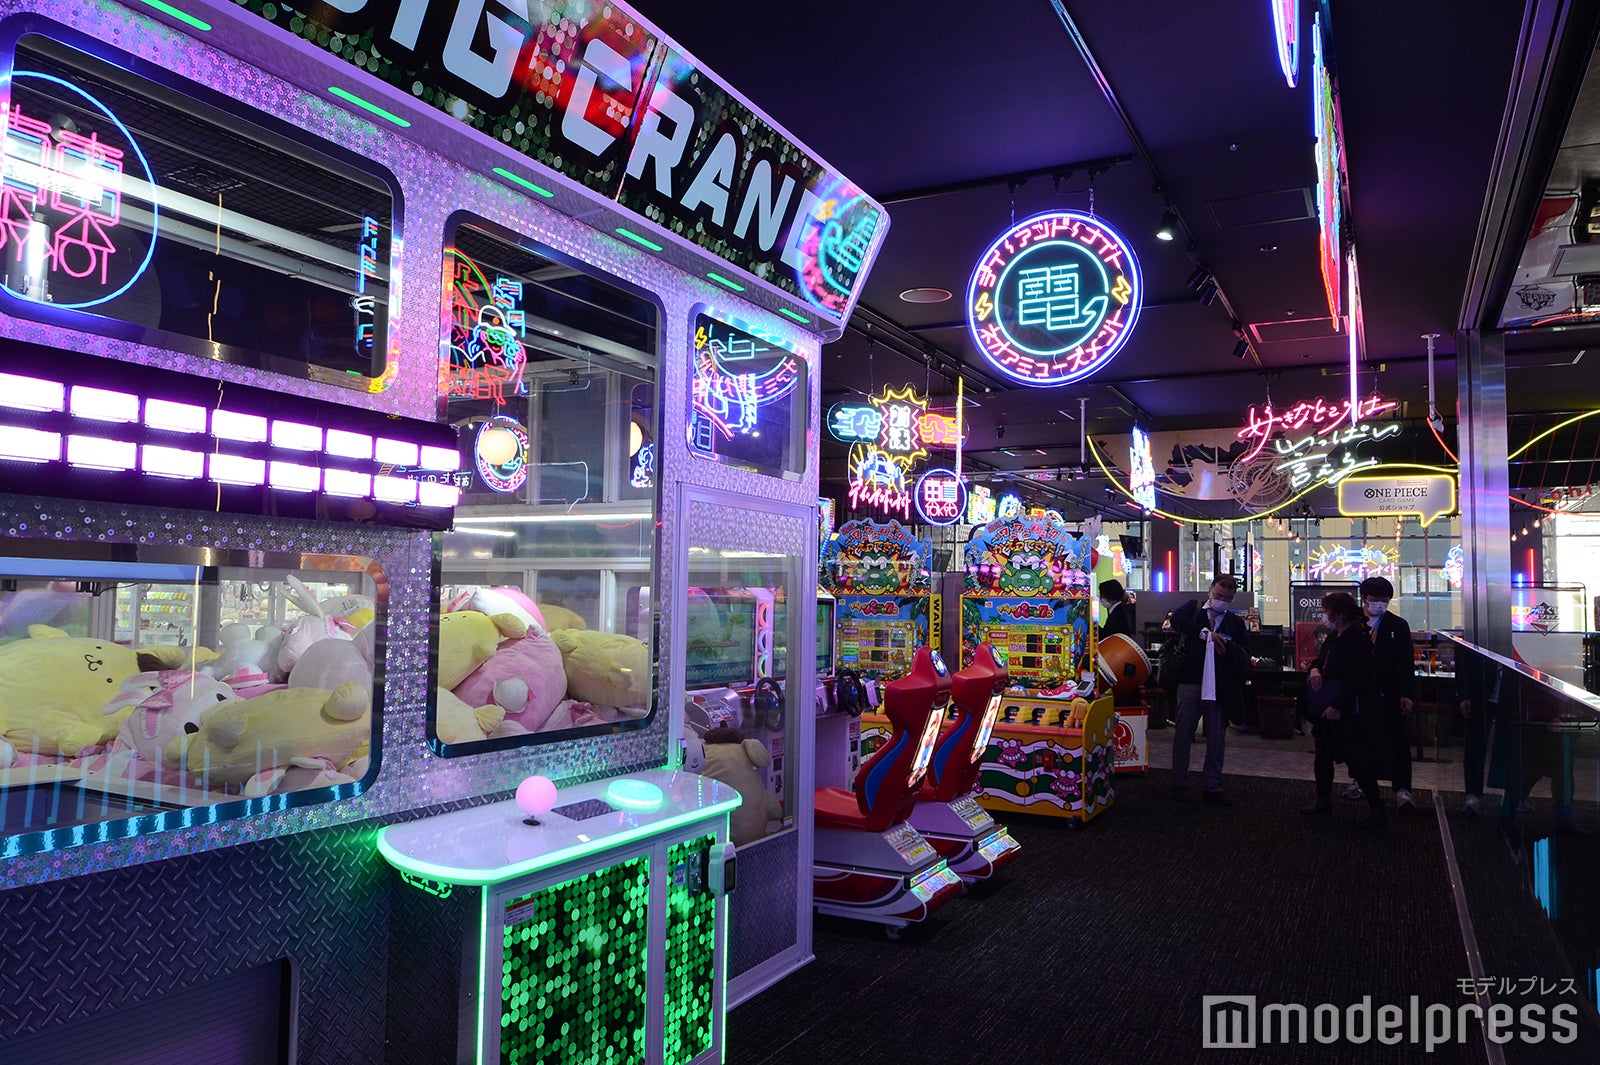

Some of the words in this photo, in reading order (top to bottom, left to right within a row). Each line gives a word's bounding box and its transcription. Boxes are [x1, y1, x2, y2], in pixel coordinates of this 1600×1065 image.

[1364, 488, 1391, 498] ONE
[1395, 487, 1428, 497] PIECE
[926, 505, 959, 517] TOKYO
[1299, 598, 1322, 608] ONE
